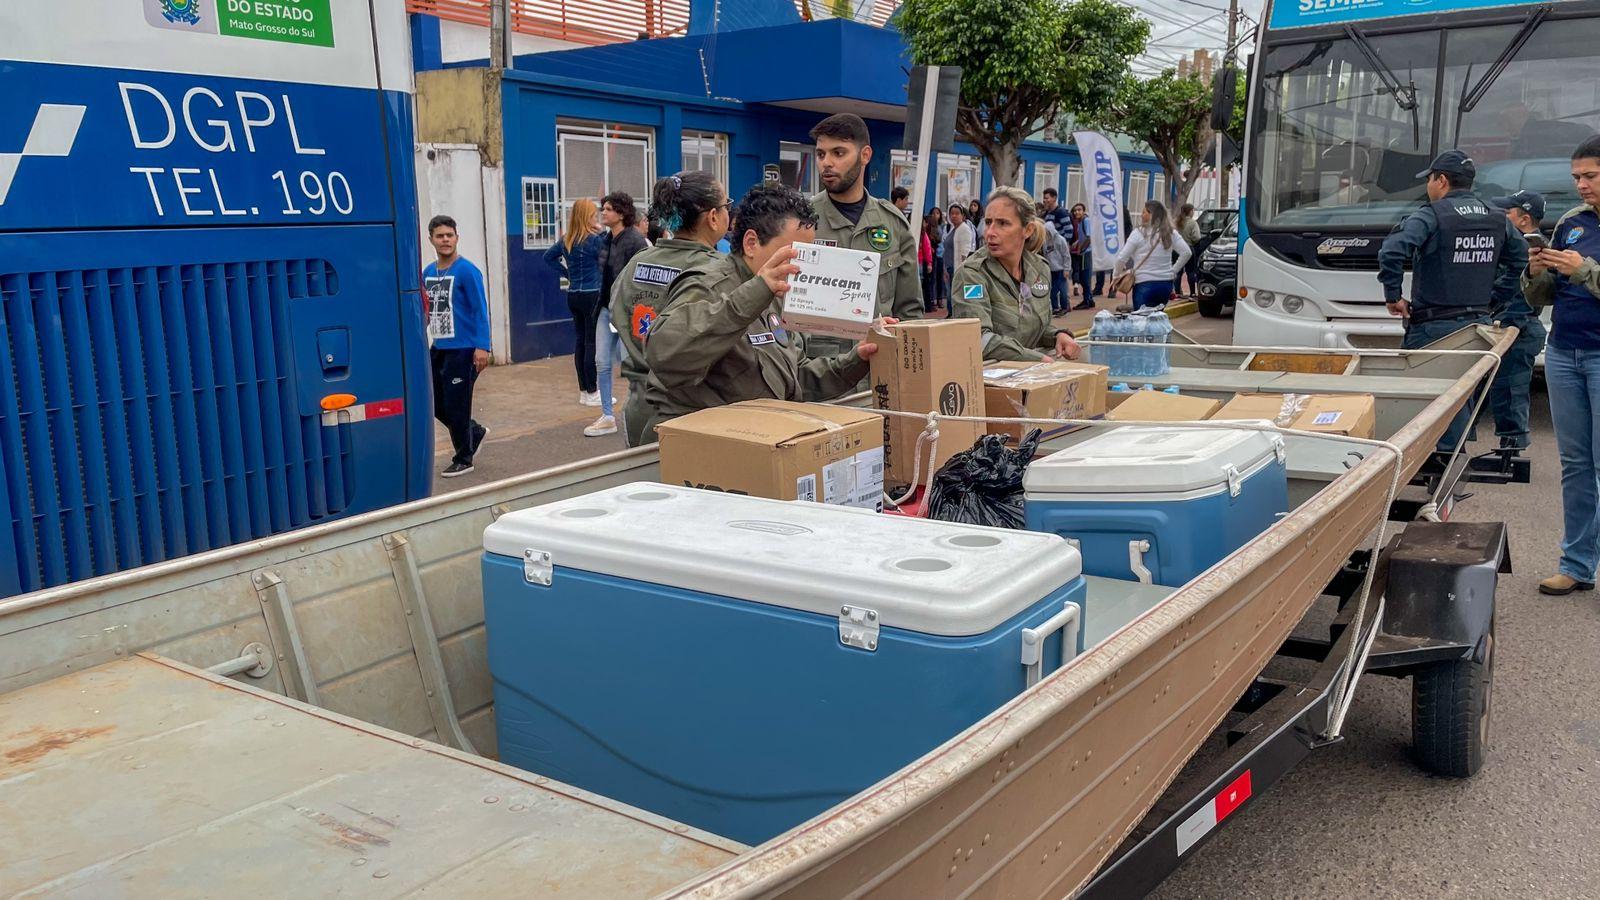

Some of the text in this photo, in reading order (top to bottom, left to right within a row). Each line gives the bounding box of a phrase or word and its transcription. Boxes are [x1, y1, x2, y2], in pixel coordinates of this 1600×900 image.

[228, 0, 314, 22] DO ESTADO
[229, 19, 315, 38] Mato Grosso do Sul
[118, 82, 326, 155] DGPL
[130, 167, 354, 216] TEL. 190
[1095, 150, 1119, 255] CECAMP
[1455, 234, 1495, 249] POLÍCIA
[1453, 250, 1494, 263] MILITAR
[793, 270, 861, 290] Terracam
[840, 289, 872, 303] Spray
